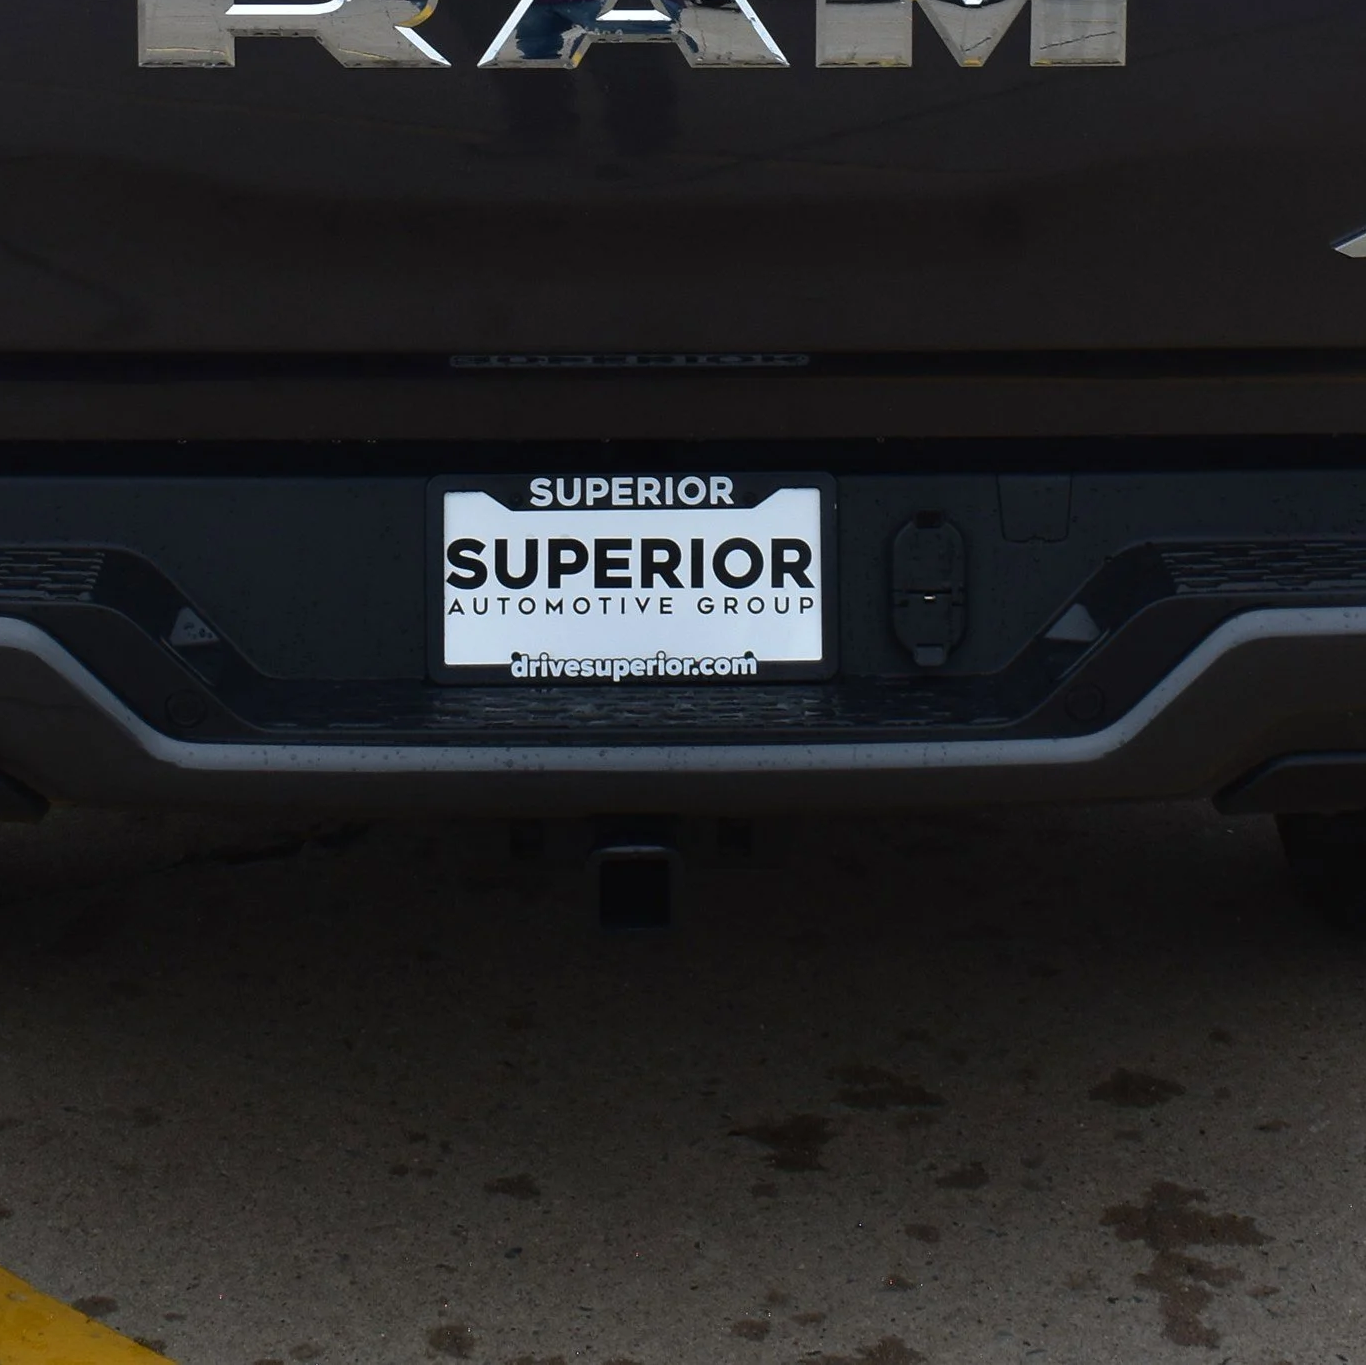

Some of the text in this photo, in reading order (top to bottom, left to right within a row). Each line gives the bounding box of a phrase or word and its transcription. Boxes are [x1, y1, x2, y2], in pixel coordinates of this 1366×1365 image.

[529, 476, 736, 507] SUPERIOR
[445, 537, 816, 590] SUPERIOR
[447, 595, 816, 616] AUTOMOTIVE GROUP
[510, 650, 758, 682] drivesuperior.com
